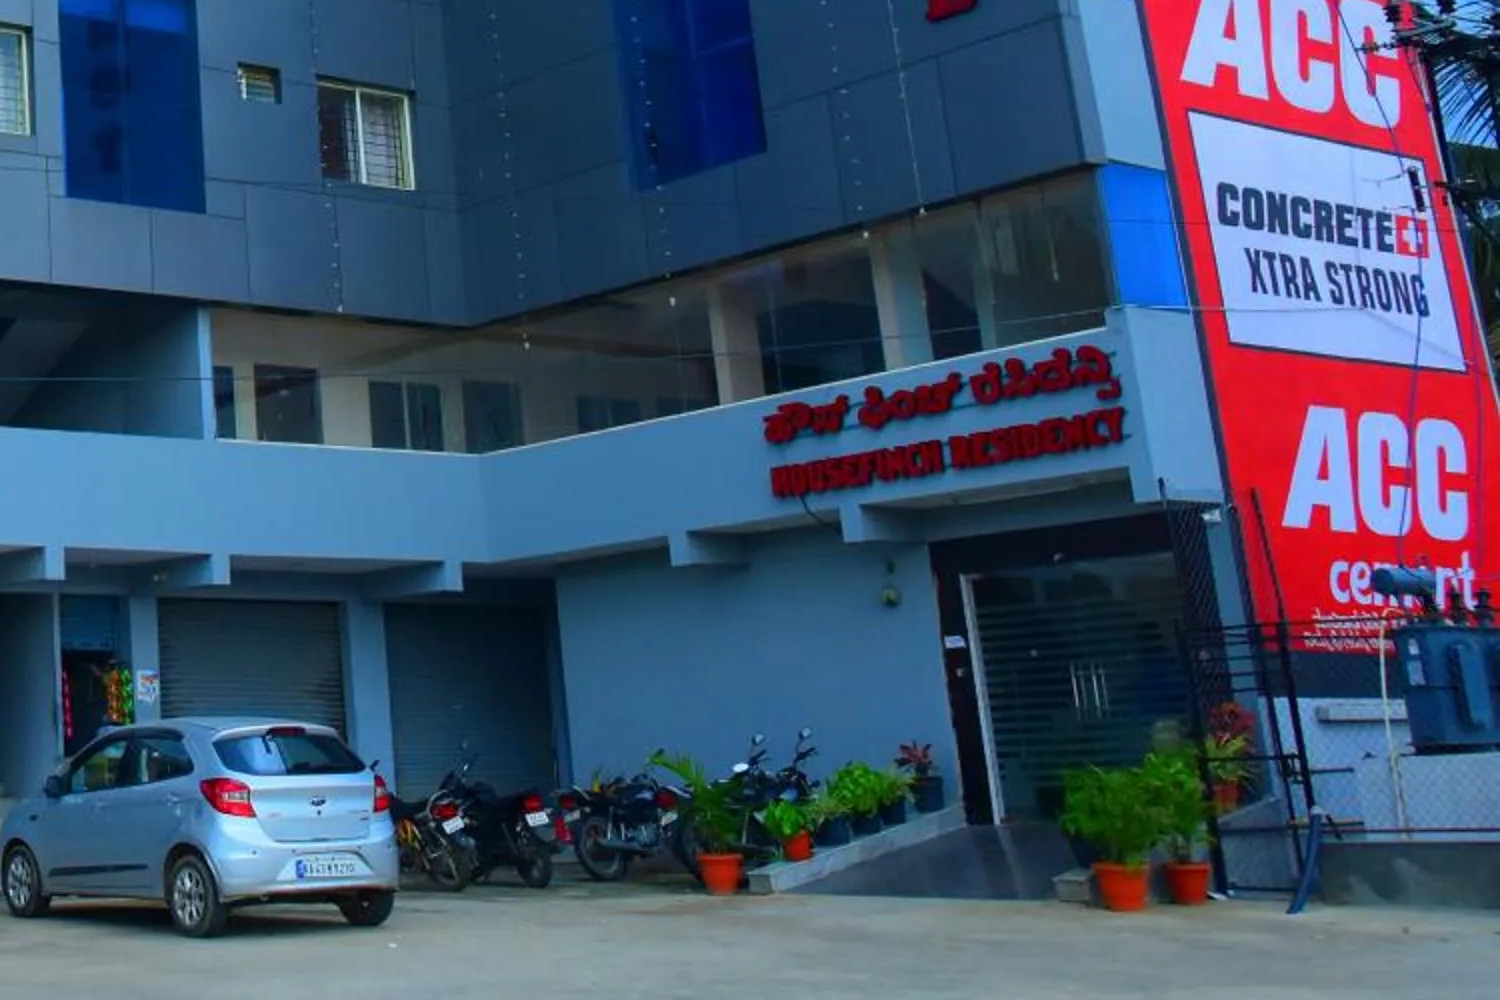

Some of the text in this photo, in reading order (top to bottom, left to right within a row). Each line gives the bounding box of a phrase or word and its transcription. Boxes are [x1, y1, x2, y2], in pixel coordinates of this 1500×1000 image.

[1216, 180, 1395, 253] CONCRETE
[1243, 246, 1431, 319] XTRA STRONG
[949, 406, 1126, 471] RESIDENCY
[1281, 404, 1469, 541] ACC
